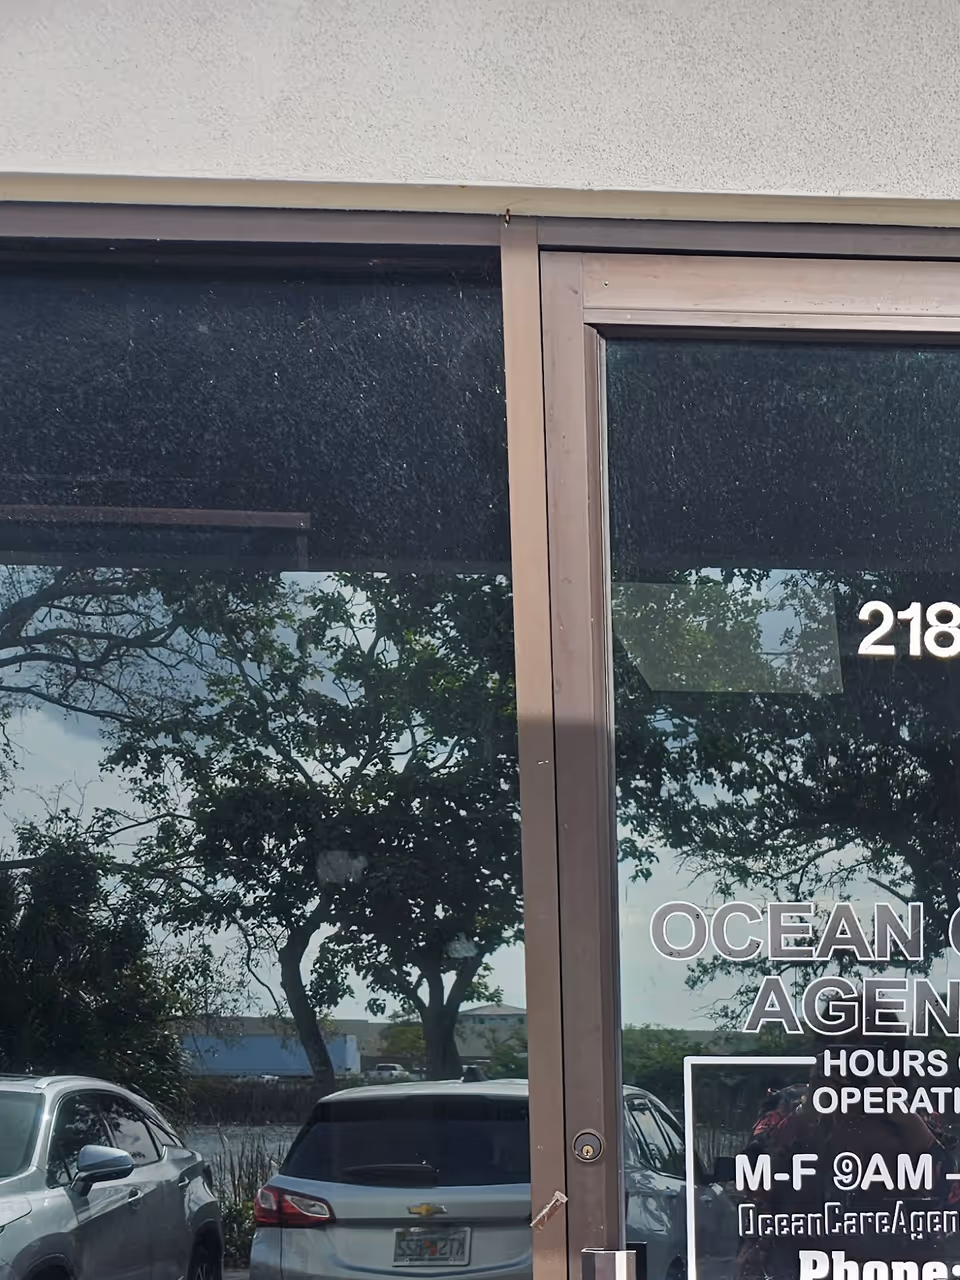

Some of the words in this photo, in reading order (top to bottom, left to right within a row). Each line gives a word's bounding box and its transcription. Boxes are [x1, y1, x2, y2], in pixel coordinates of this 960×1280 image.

[649, 900, 923, 961] OCEAN
[823, 1049, 948, 1078] HOURS
[735, 1153, 819, 1192] M-F
[833, 1151, 933, 1191] 9AM
